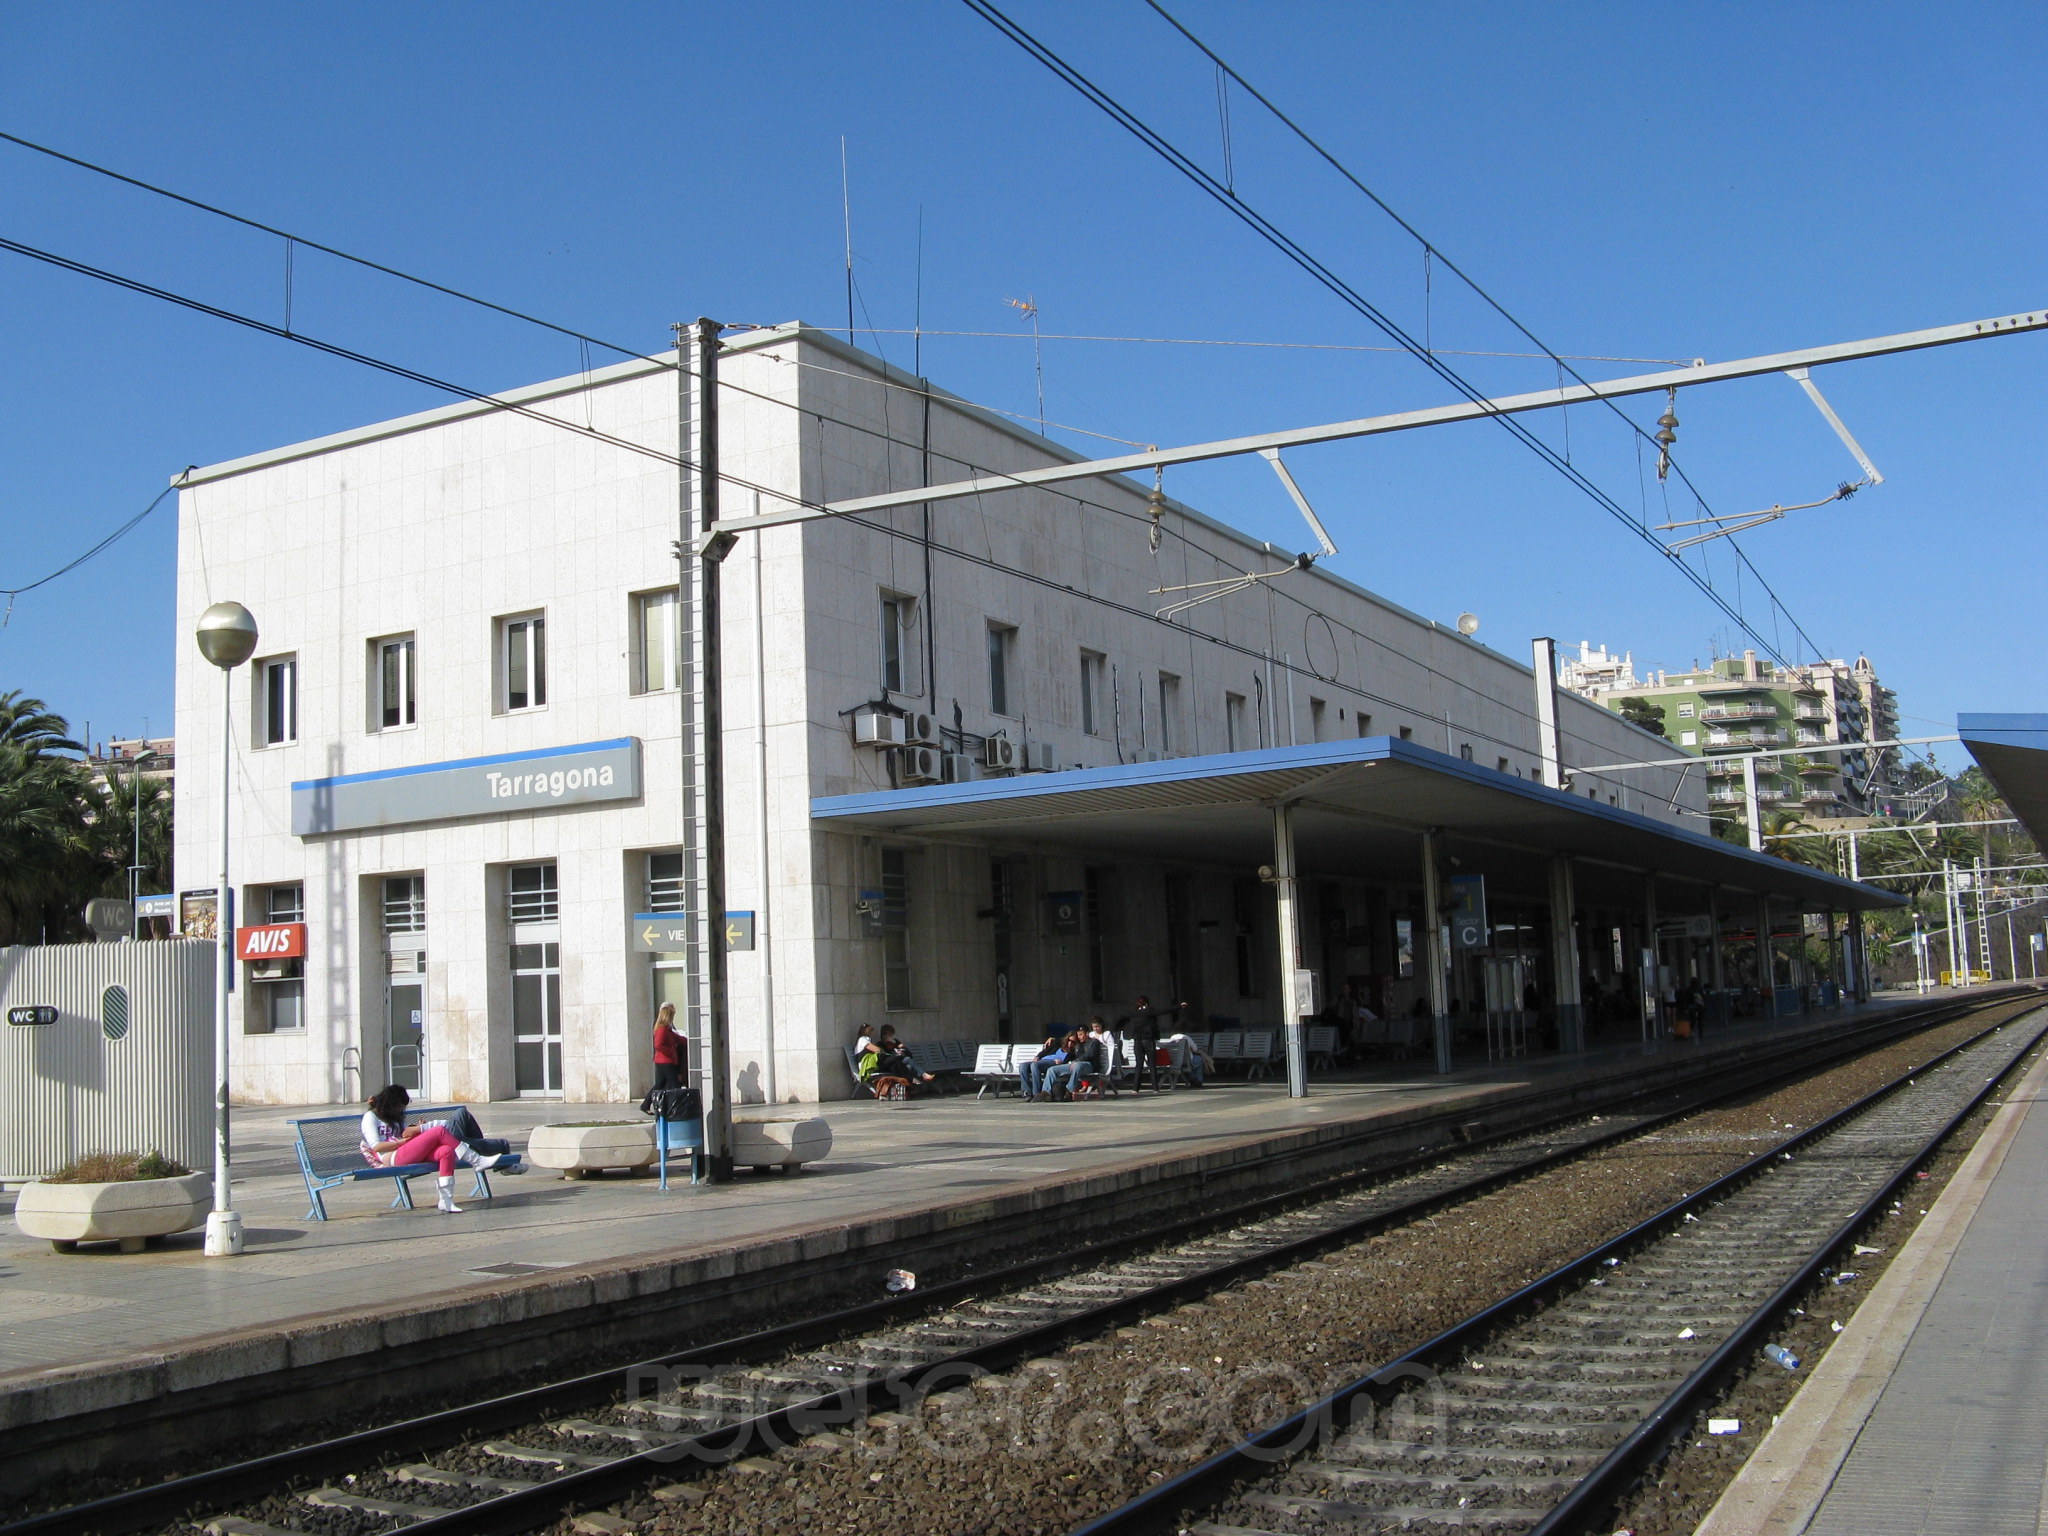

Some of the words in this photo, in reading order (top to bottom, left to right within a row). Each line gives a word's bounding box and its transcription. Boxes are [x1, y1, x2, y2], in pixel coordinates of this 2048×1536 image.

[486, 765, 614, 798] Tarragona
[1463, 894, 1473, 912] 1
[102, 906, 125, 927] WC
[1455, 916, 1480, 926] Sector
[245, 928, 291, 954] AVIS
[667, 929, 685, 941] VIE
[1462, 926, 1477, 945] C
[12, 1010, 35, 1023] WC
